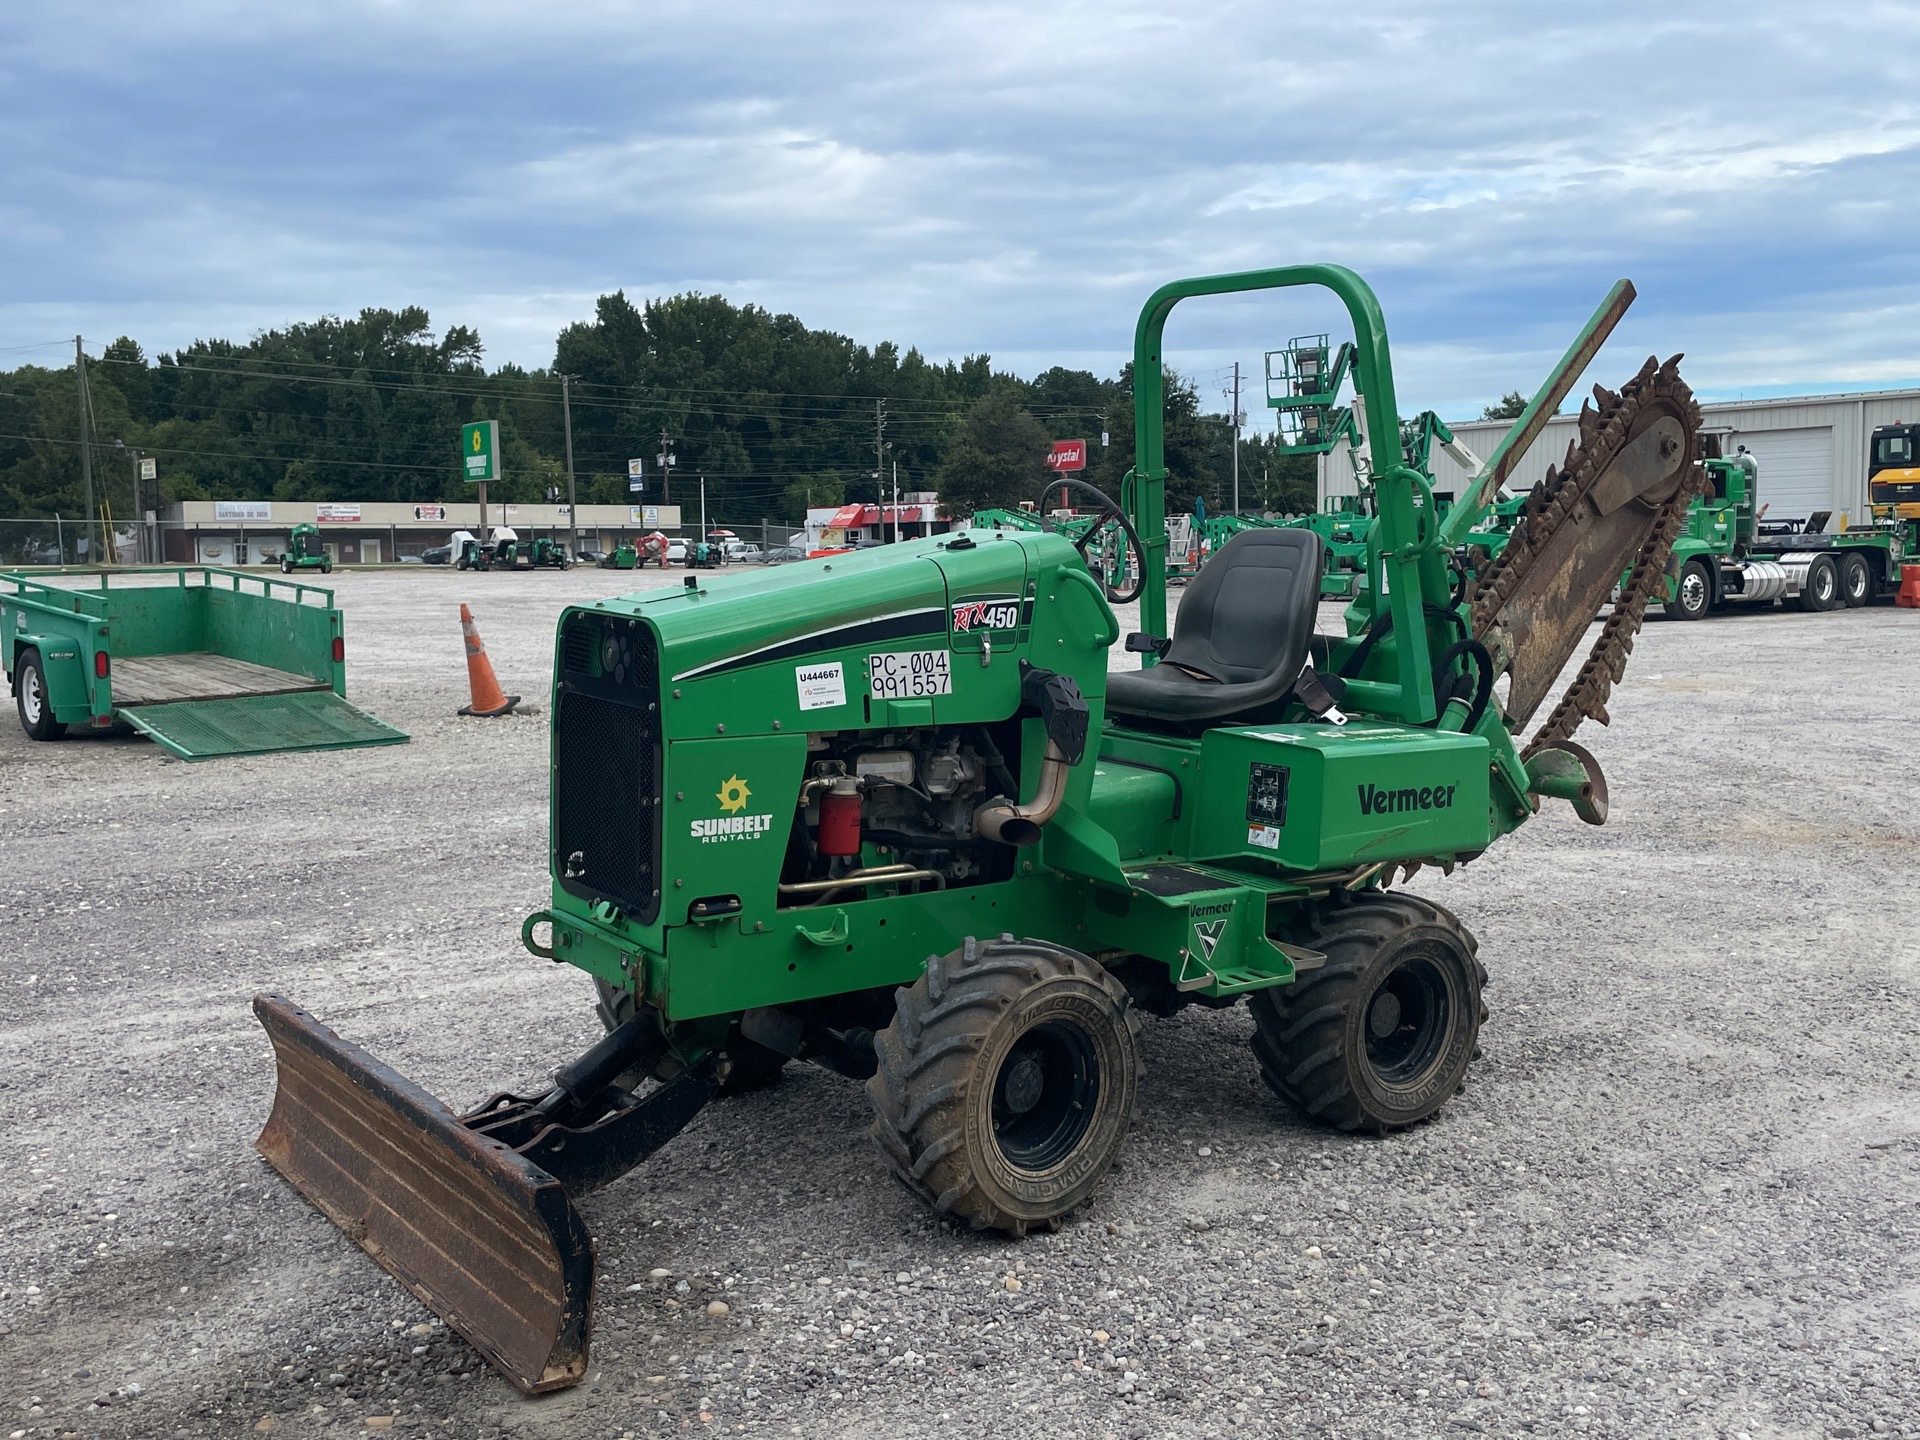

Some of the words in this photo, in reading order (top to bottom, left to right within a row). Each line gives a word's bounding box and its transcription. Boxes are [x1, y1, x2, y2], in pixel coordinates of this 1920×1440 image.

[800, 669, 839, 682] U444667
[871, 651, 947, 677] PC-004
[872, 673, 949, 698] 991557
[1357, 783, 1456, 815] Vermeer
[690, 814, 773, 837] SUNBELT
[702, 832, 761, 844] RENTALS
[1190, 902, 1233, 917] Vermeer
[1386, 1078, 1440, 1107] GUARD
[993, 1160, 1053, 1197] GUARD
[1059, 1154, 1093, 1190] RIM
